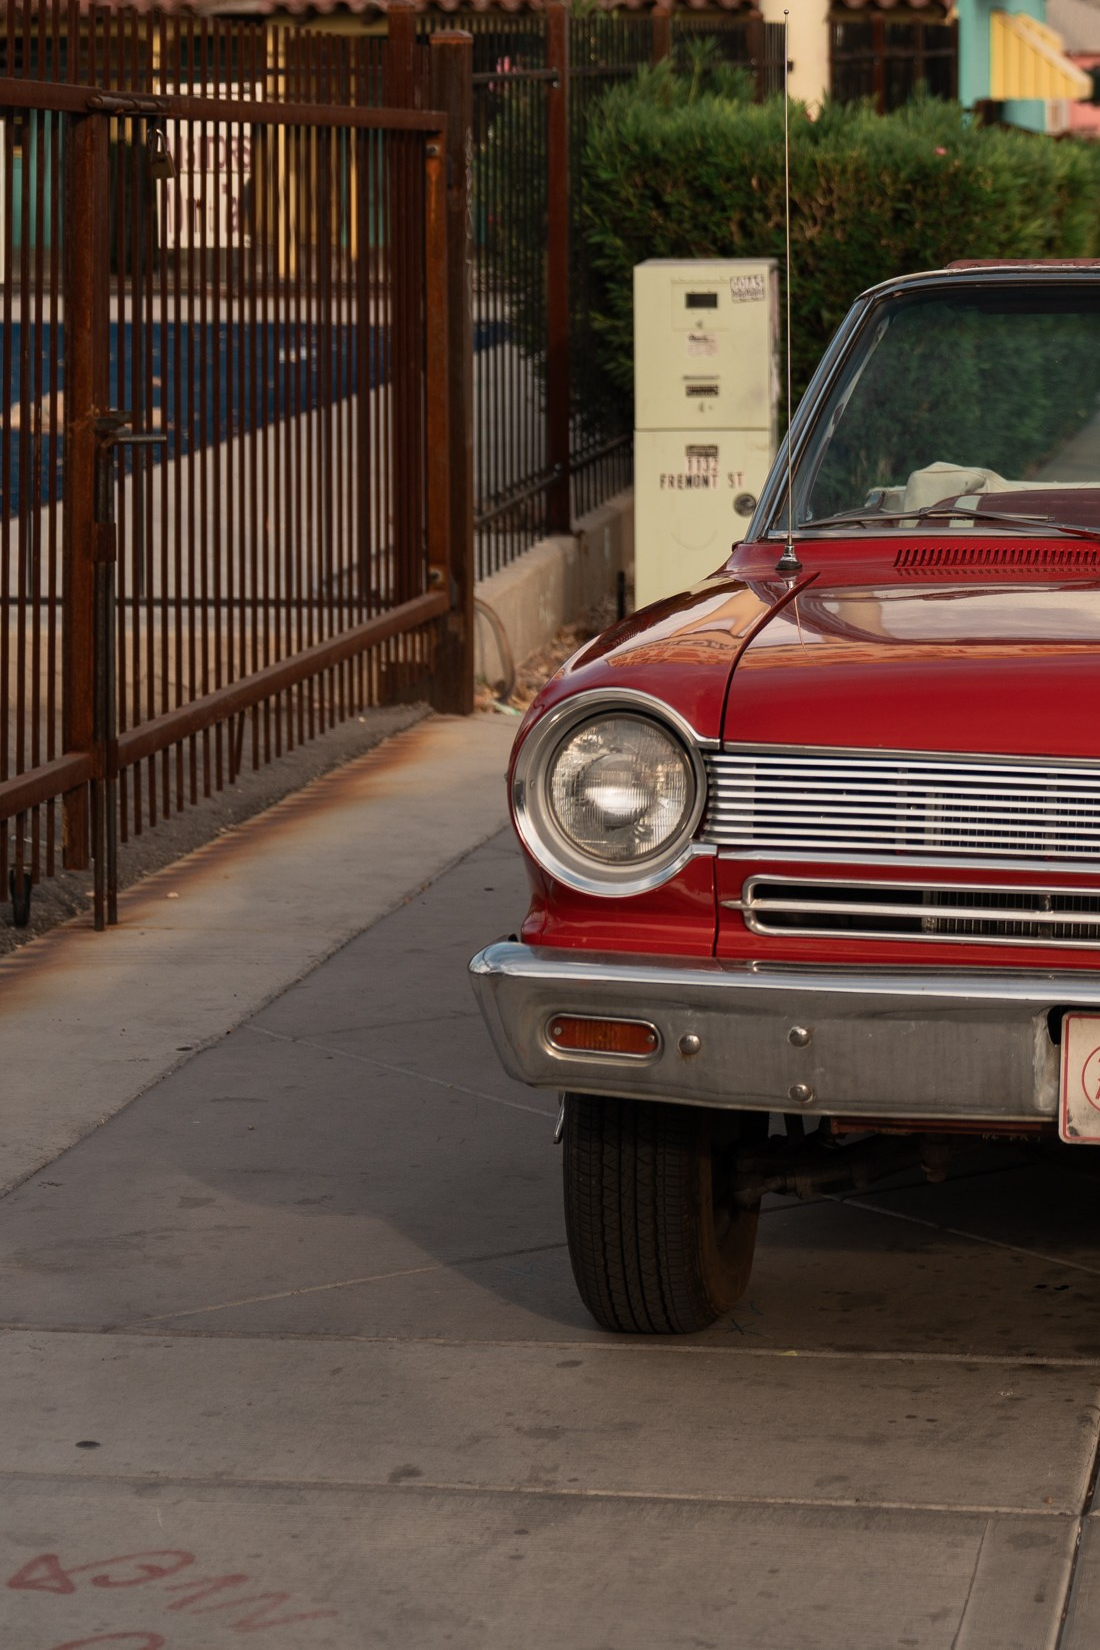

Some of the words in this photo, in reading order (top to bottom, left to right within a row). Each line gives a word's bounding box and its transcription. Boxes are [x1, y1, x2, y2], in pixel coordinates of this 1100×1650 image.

[687, 455, 718, 474] 1132
[660, 472, 719, 490] FREMONT
[727, 471, 744, 489] ST
